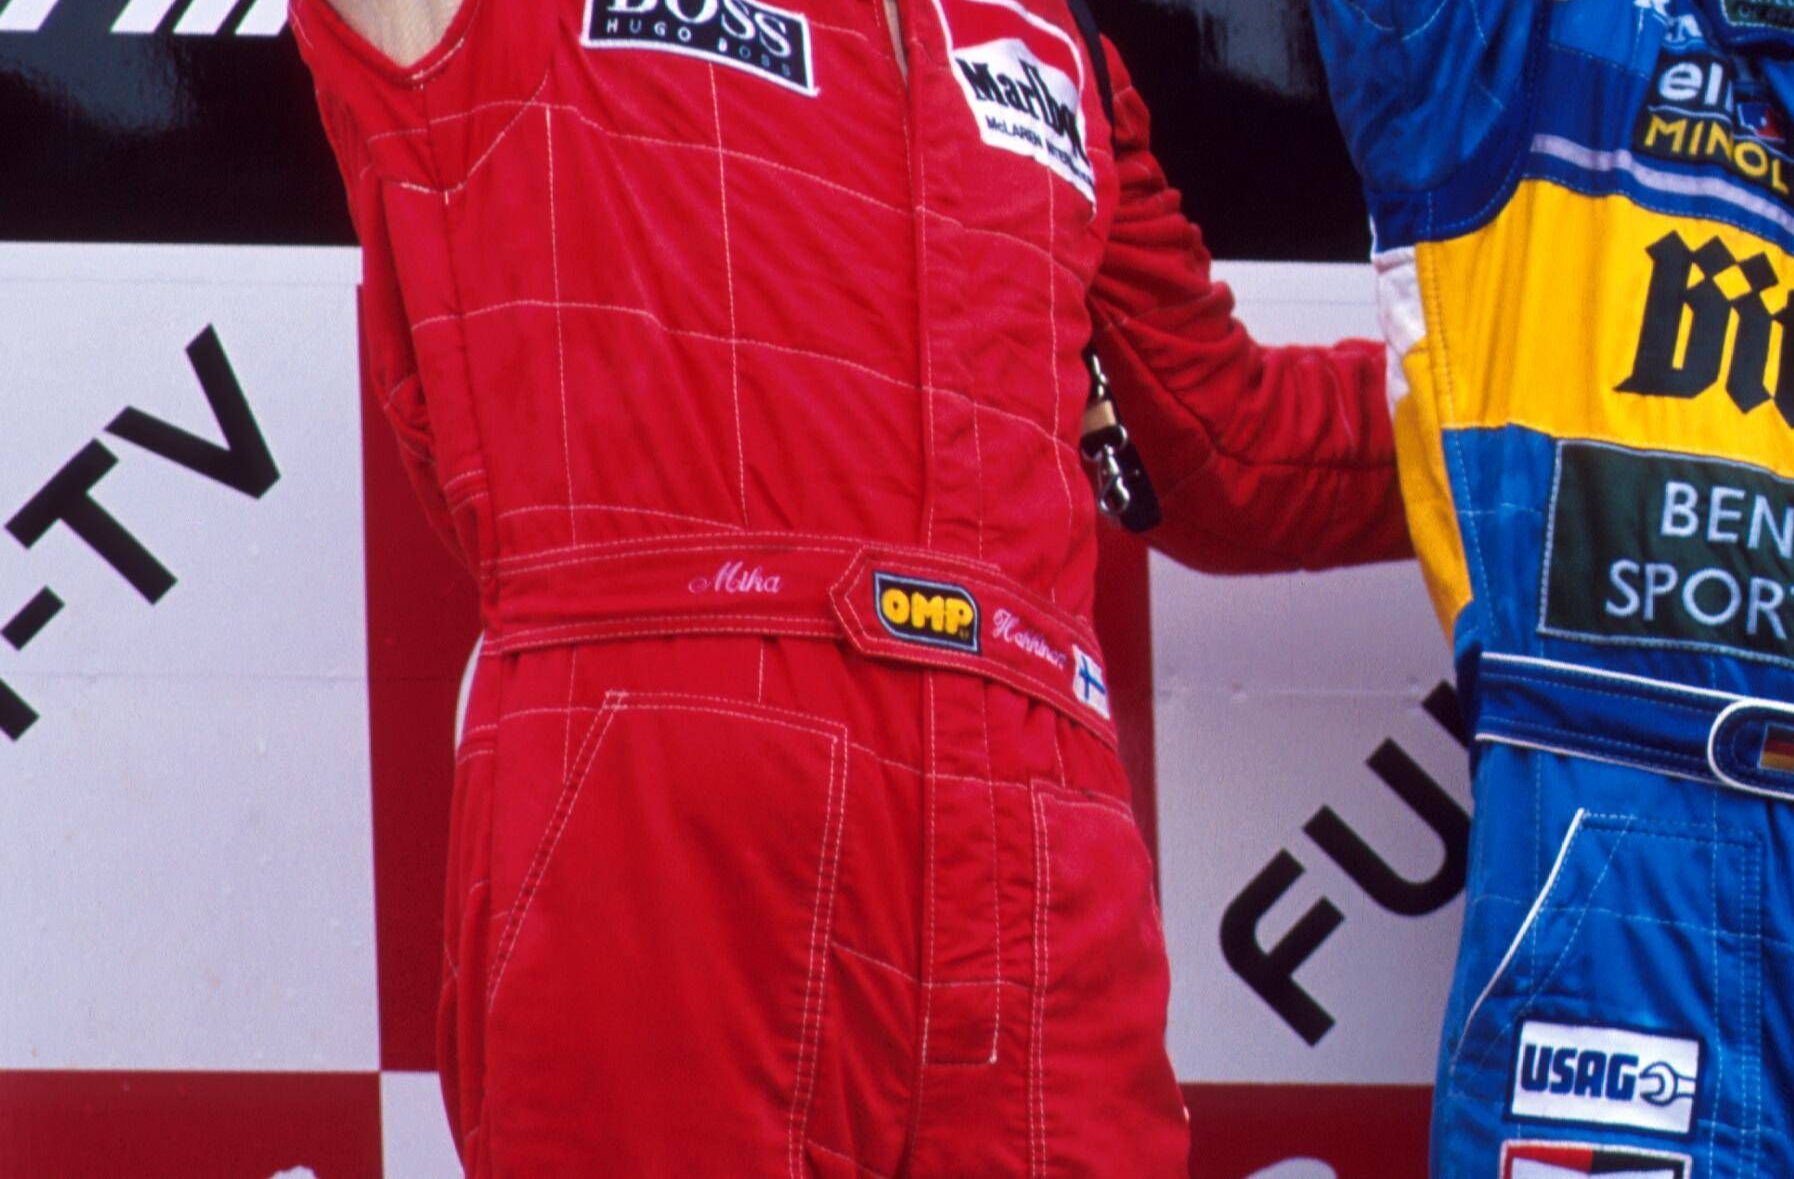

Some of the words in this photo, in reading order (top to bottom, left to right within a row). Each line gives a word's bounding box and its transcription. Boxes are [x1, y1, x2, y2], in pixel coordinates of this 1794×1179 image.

[606, 18, 693, 43] HUGO
[717, 37, 792, 78] BOSS
[1643, 113, 1790, 195] MINOL
[687, 559, 782, 595] Mika
[880, 586, 975, 636] OMP
[1519, 1043, 1640, 1102] USAG
